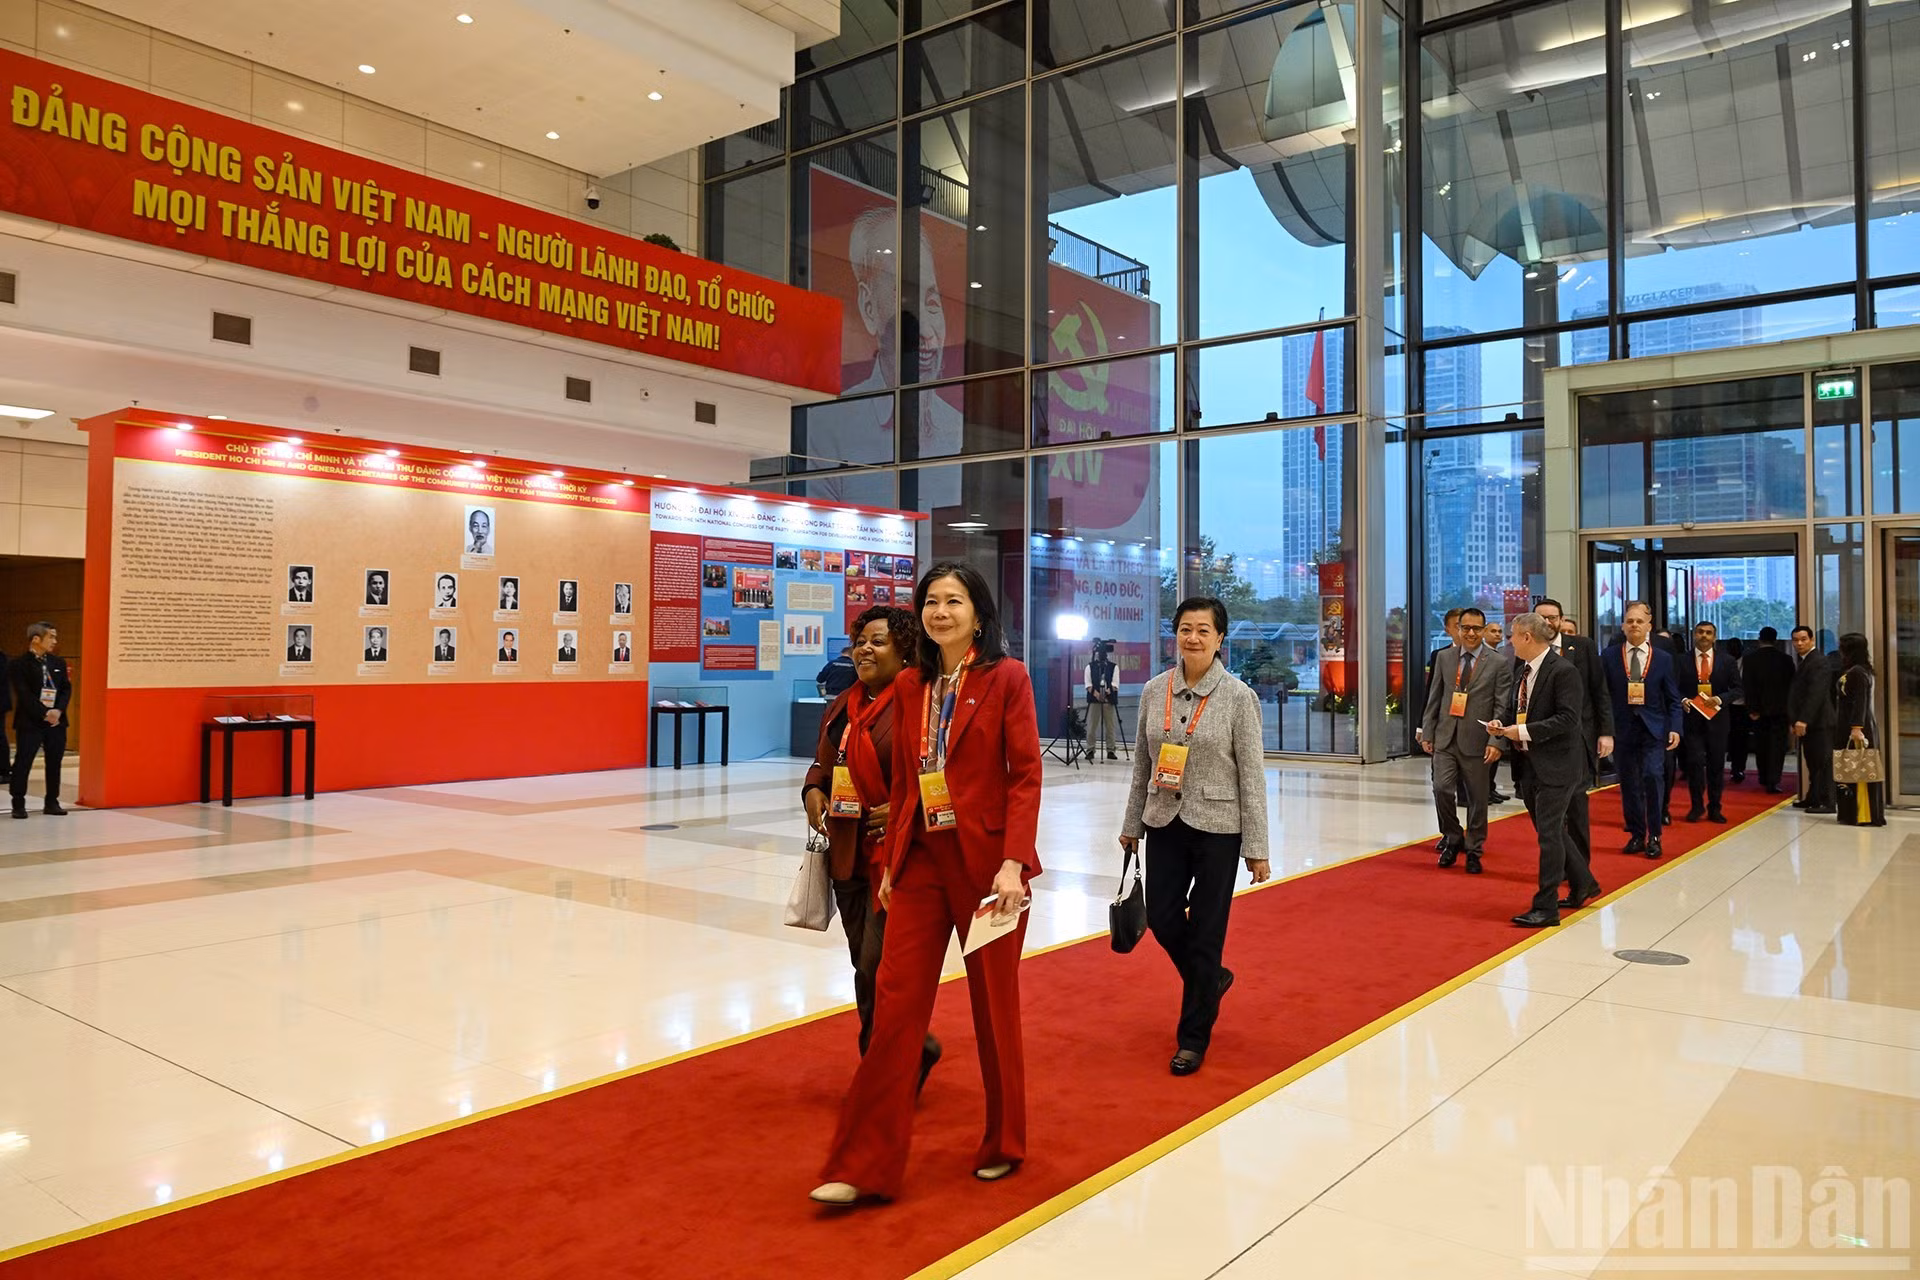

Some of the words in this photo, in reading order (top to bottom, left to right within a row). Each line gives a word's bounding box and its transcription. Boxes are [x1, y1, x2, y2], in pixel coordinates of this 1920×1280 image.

[11, 84, 127, 153] ĐẢNG
[140, 124, 241, 183] CỘNG
[254, 152, 322, 205] SẢN
[333, 179, 397, 225] VIỆT
[405, 198, 470, 244] NAM
[498, 224, 573, 271] NGƯỜI
[581, 246, 639, 289] LÃNH
[645, 266, 691, 306] ĐẠO,
[698, 275, 722, 310] TỔ
[727, 289, 775, 324] CHỨC
[133, 180, 206, 234] MỌI
[218, 201, 329, 259] THẮNG
[340, 232, 386, 276] LỢI
[396, 242, 453, 289] CỦA
[462, 262, 531, 307] CÁCH
[539, 282, 609, 325] MẠNG
[616, 301, 661, 340] VIỆT
[667, 314, 720, 351] NAM!
[175, 448, 227, 462] PRESIDENT
[229, 455, 243, 463] HO
[245, 457, 260, 465] CHI
[308, 464, 346, 475] GENERAL
[410, 475, 425, 484] THE
[225, 442, 249, 454] CHỦ
[314, 454, 341, 464] MINH
[342, 456, 356, 466] VÀ
[416, 465, 441, 476] ĐẢNG
[504, 478, 523, 486] NAM
[1051, 448, 1104, 485] XIV
[1095, 581, 1118, 600] ĐẠO
[1120, 580, 1144, 600] ĐỨC,
[1093, 602, 1112, 620] CHÍ
[1114, 606, 1144, 621] MINH!
